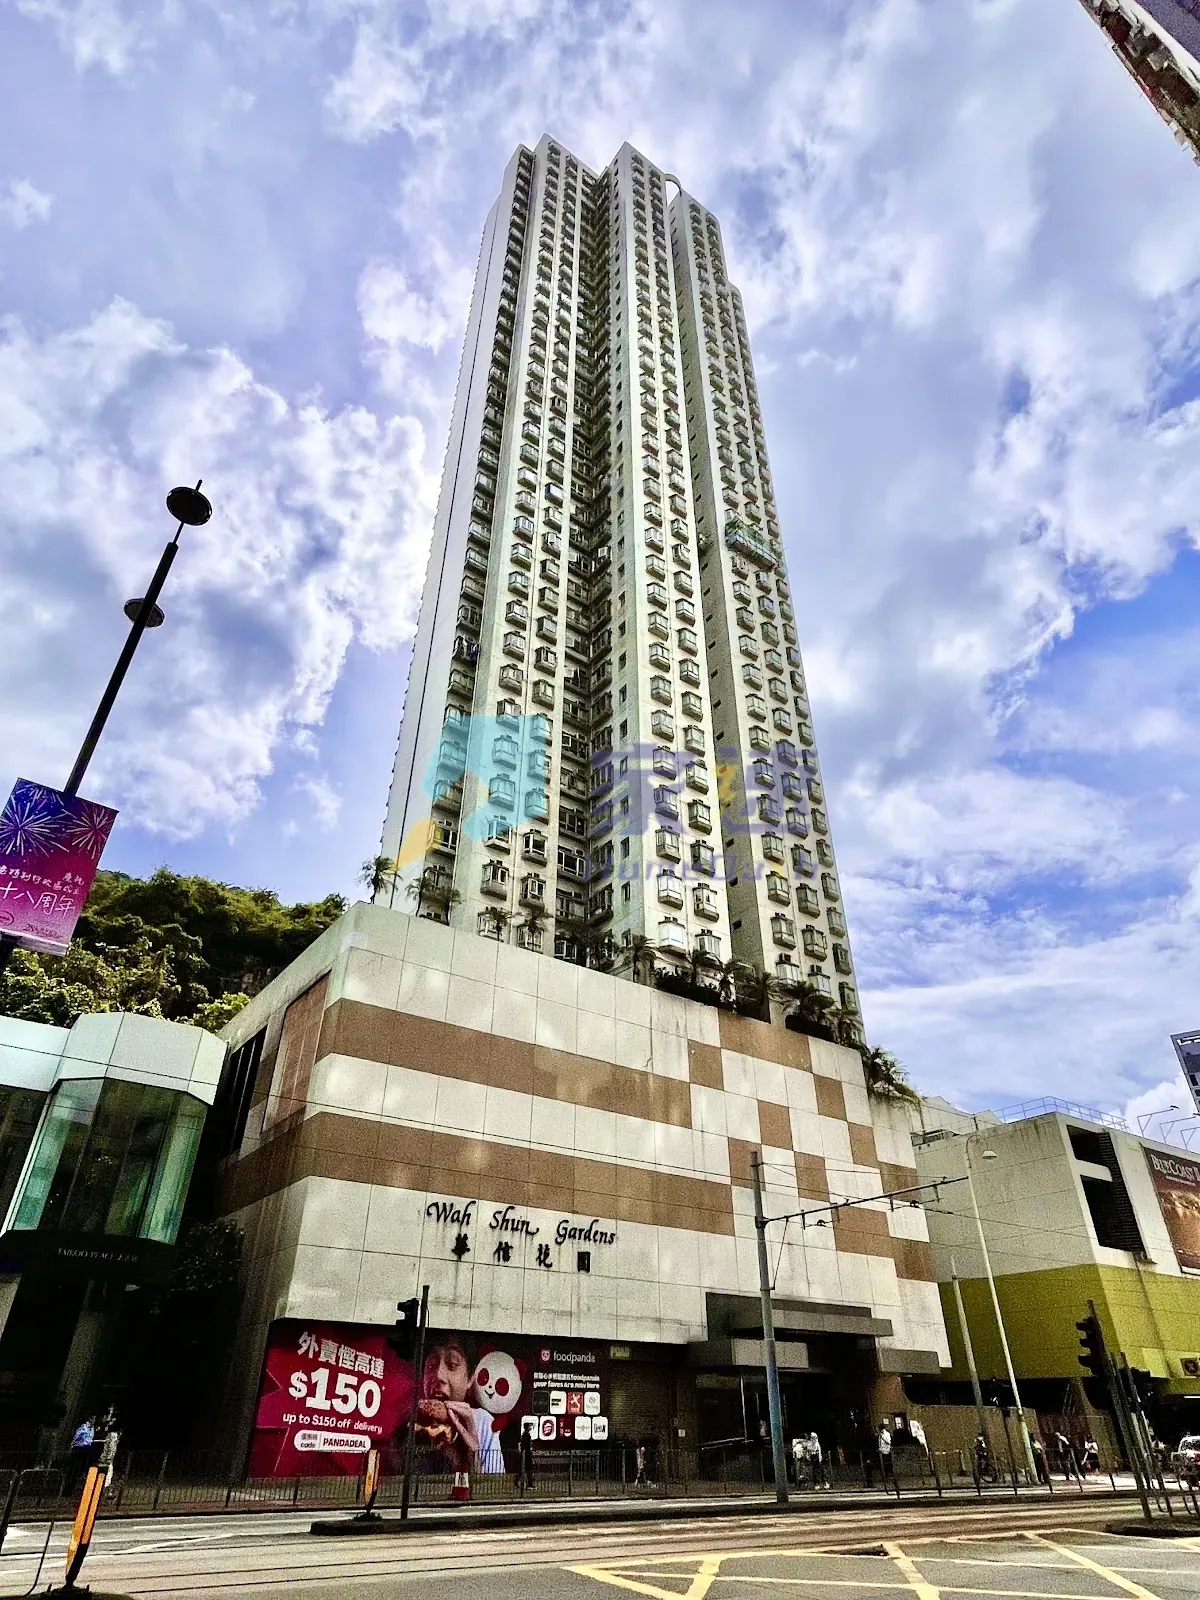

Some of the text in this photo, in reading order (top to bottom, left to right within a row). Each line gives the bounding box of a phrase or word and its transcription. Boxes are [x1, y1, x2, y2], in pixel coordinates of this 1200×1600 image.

[426, 1200, 617, 1245] Wah Shun Gardens
[553, 1350, 596, 1363] foodpanda
[282, 1411, 383, 1435] up to $150 off delivery
[323, 1437, 367, 1449] PANDADEAL
